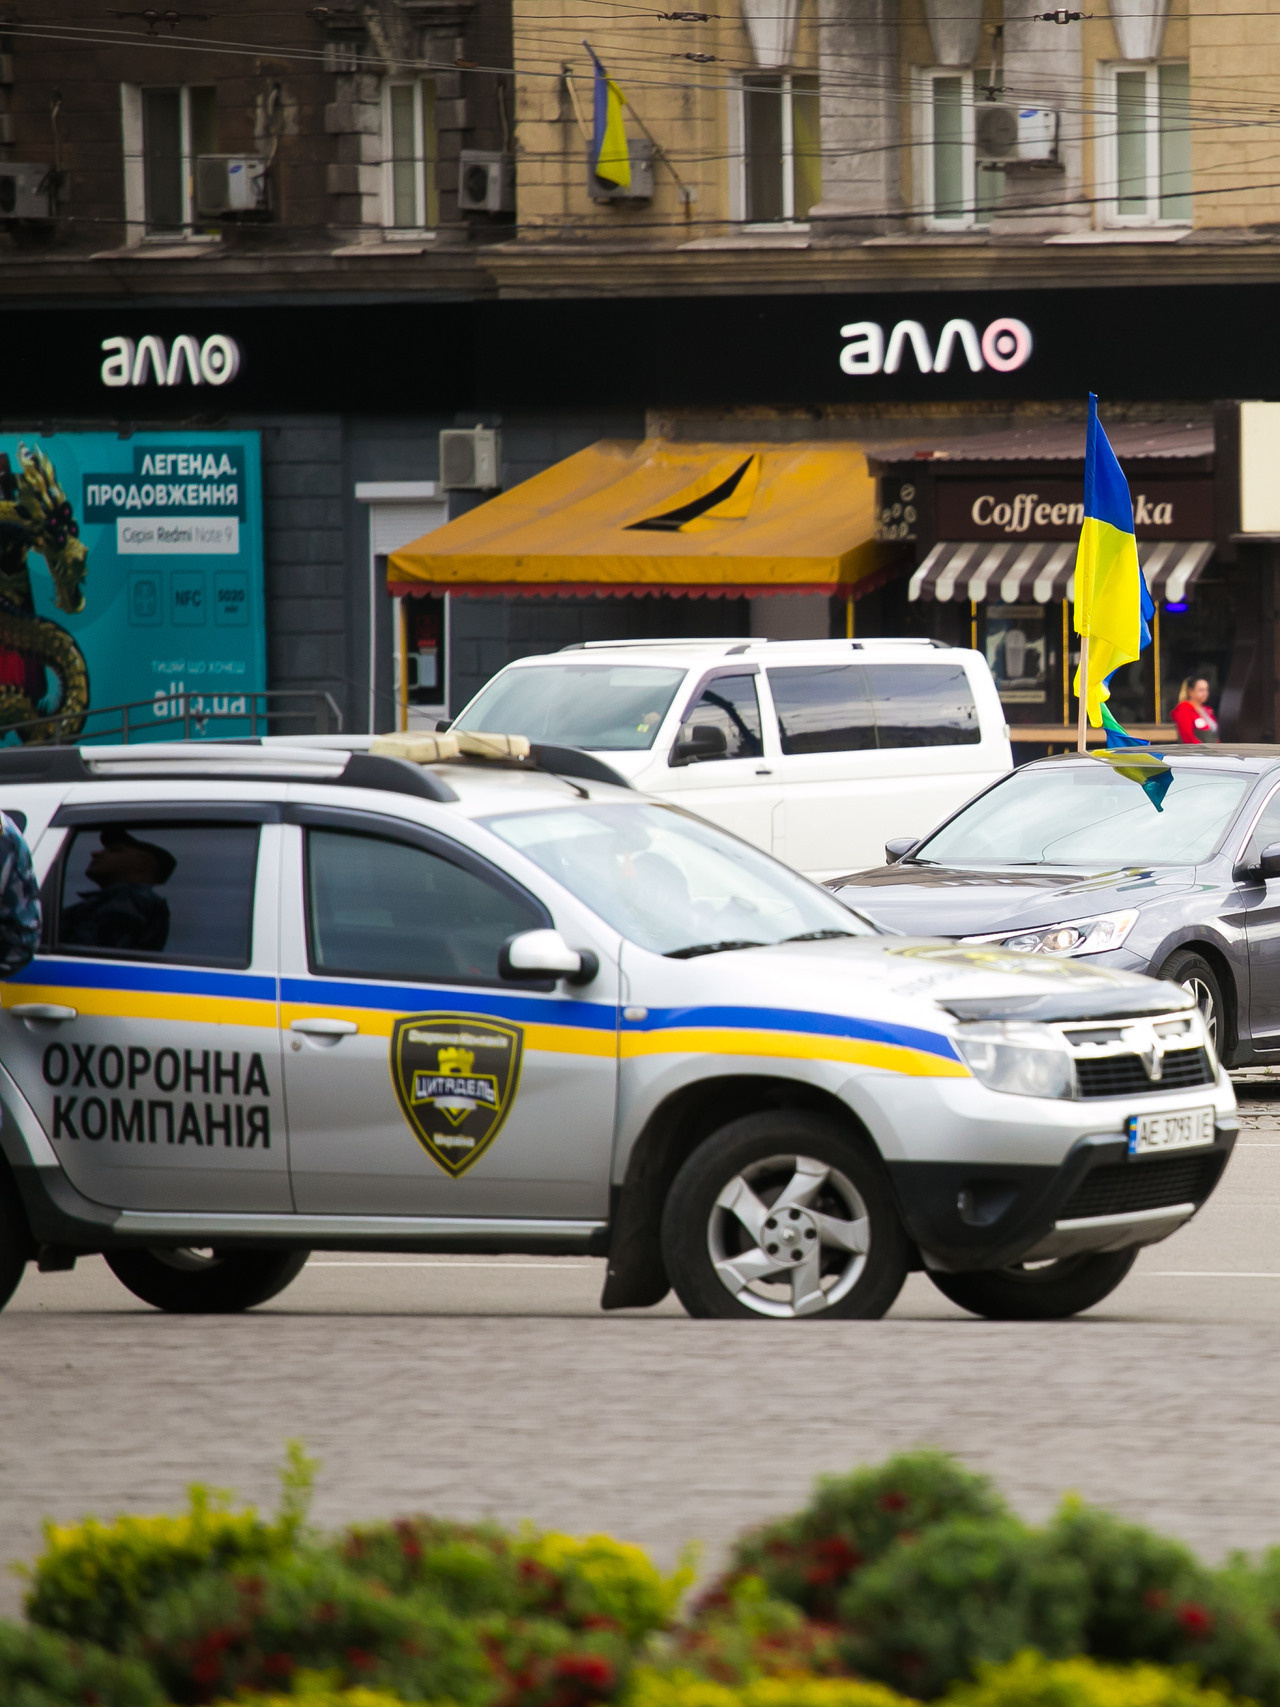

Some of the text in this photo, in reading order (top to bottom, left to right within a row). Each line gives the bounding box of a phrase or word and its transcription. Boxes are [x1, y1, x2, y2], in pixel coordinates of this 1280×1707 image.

[141, 453, 237, 479] ЛЕГЕНДА.
[87, 484, 238, 510] ПРОДОВЖЕННЯ
[157, 526, 193, 543] Redmi
[42, 1042, 271, 1097] ОХОРОННА
[53, 1095, 271, 1149] КОМПАНІЯ
